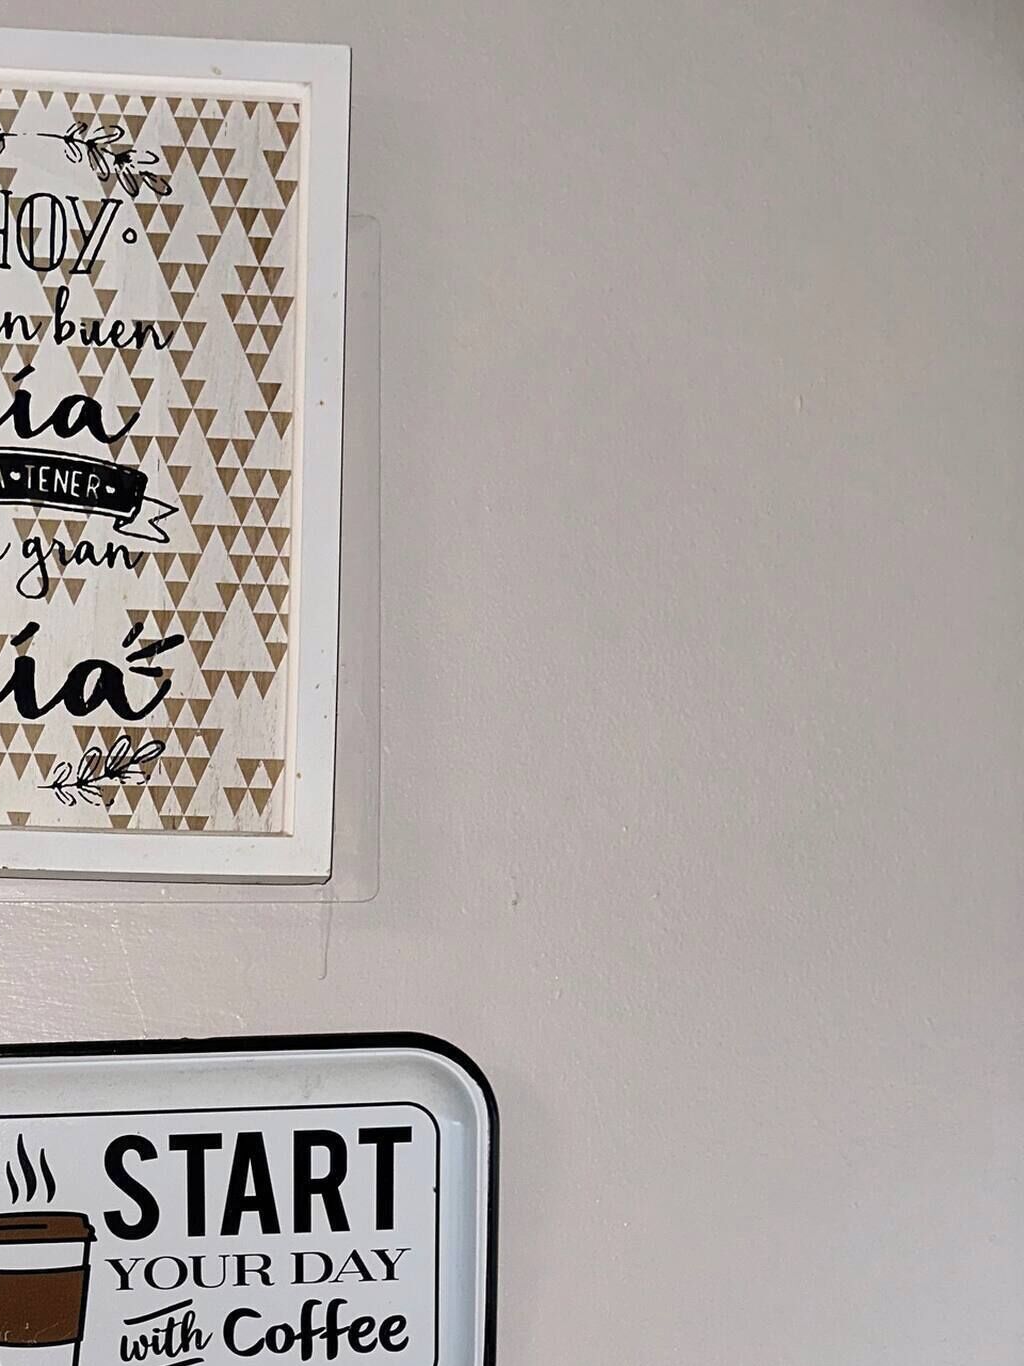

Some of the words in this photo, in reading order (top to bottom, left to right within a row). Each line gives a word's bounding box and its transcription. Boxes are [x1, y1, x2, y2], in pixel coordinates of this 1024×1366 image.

[53, 285, 175, 351] buen
[25, 464, 99, 499] TENER
[15, 536, 144, 599] gran
[103, 1126, 413, 1241] START
[104, 1252, 275, 1291] YOUR
[290, 1247, 412, 1286] DAY
[120, 1308, 213, 1363] with
[222, 1297, 410, 1362] Coffee
